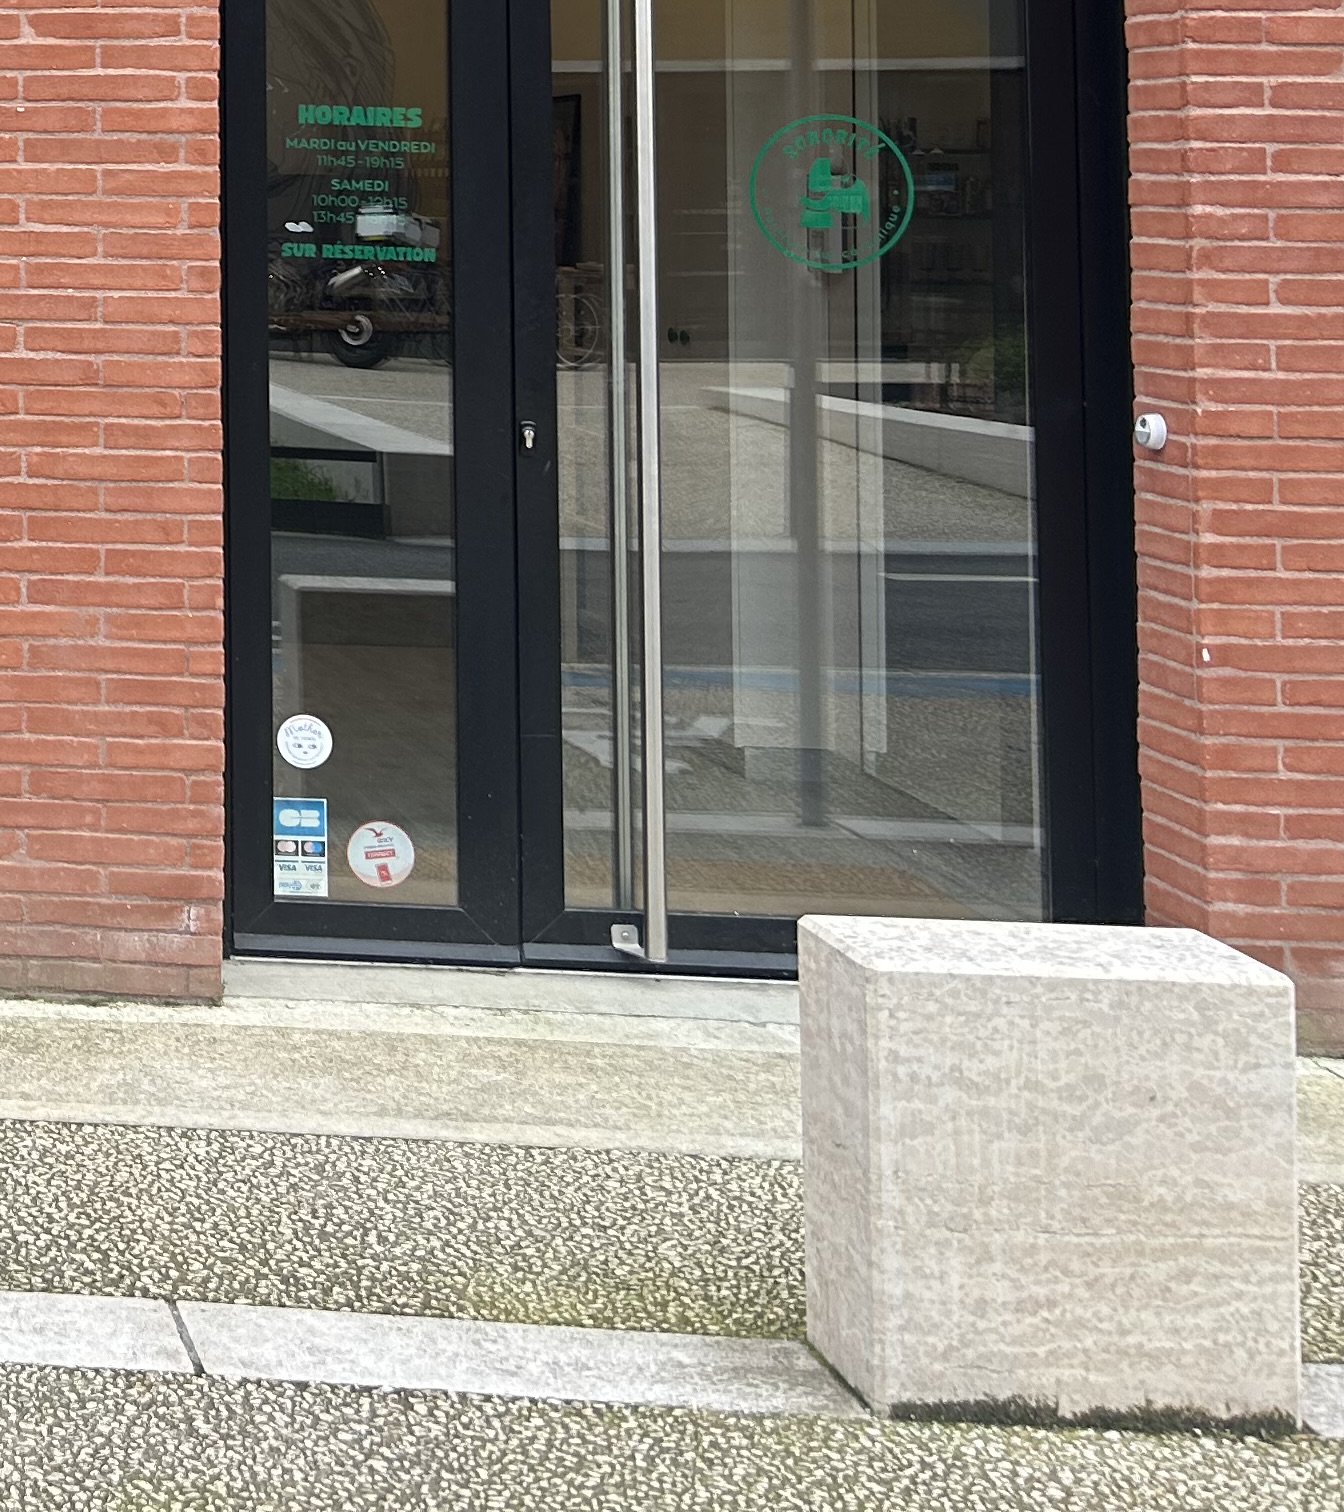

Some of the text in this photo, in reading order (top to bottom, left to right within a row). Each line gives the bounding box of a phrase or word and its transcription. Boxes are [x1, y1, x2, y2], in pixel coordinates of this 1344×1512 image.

[298, 104, 422, 128] HORAIRES
[285, 138, 436, 153] MARDI au VENDREDI
[331, 179, 389, 192] SAMEDI
[281, 241, 437, 263] SUR RÉSERVATION
[278, 863, 323, 872] VISA VISA
